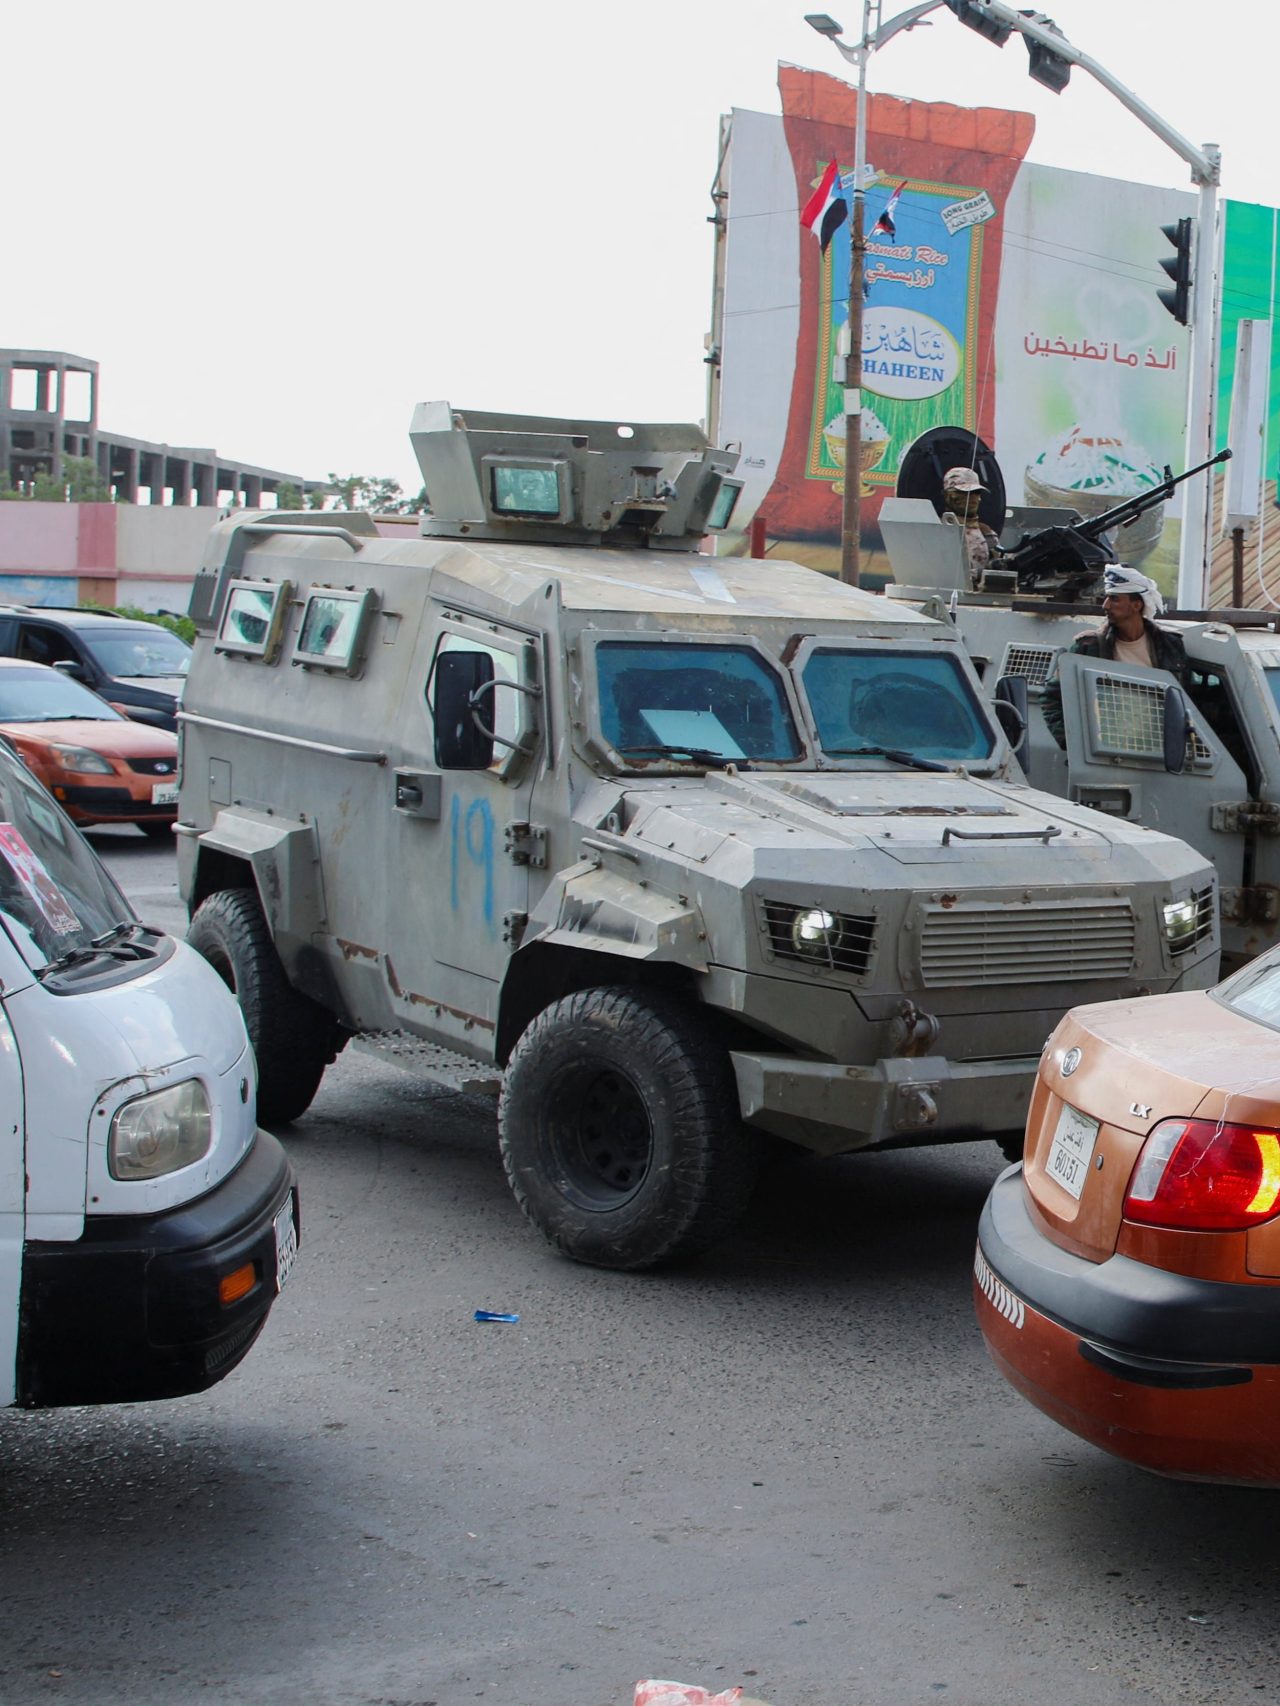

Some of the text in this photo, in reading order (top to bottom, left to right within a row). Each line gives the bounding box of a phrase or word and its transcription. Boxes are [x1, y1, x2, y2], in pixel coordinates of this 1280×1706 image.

[943, 196, 987, 219] LONG GRAIN
[864, 238, 949, 265] asmati Rice
[866, 264, 935, 287] أرز بسمتي
[1024, 332, 1178, 370] ألذ ما تطبخين
[863, 359, 945, 383] HAHEEN
[1128, 1102, 1152, 1119] LX
[1054, 1148, 1079, 1184] 60151
